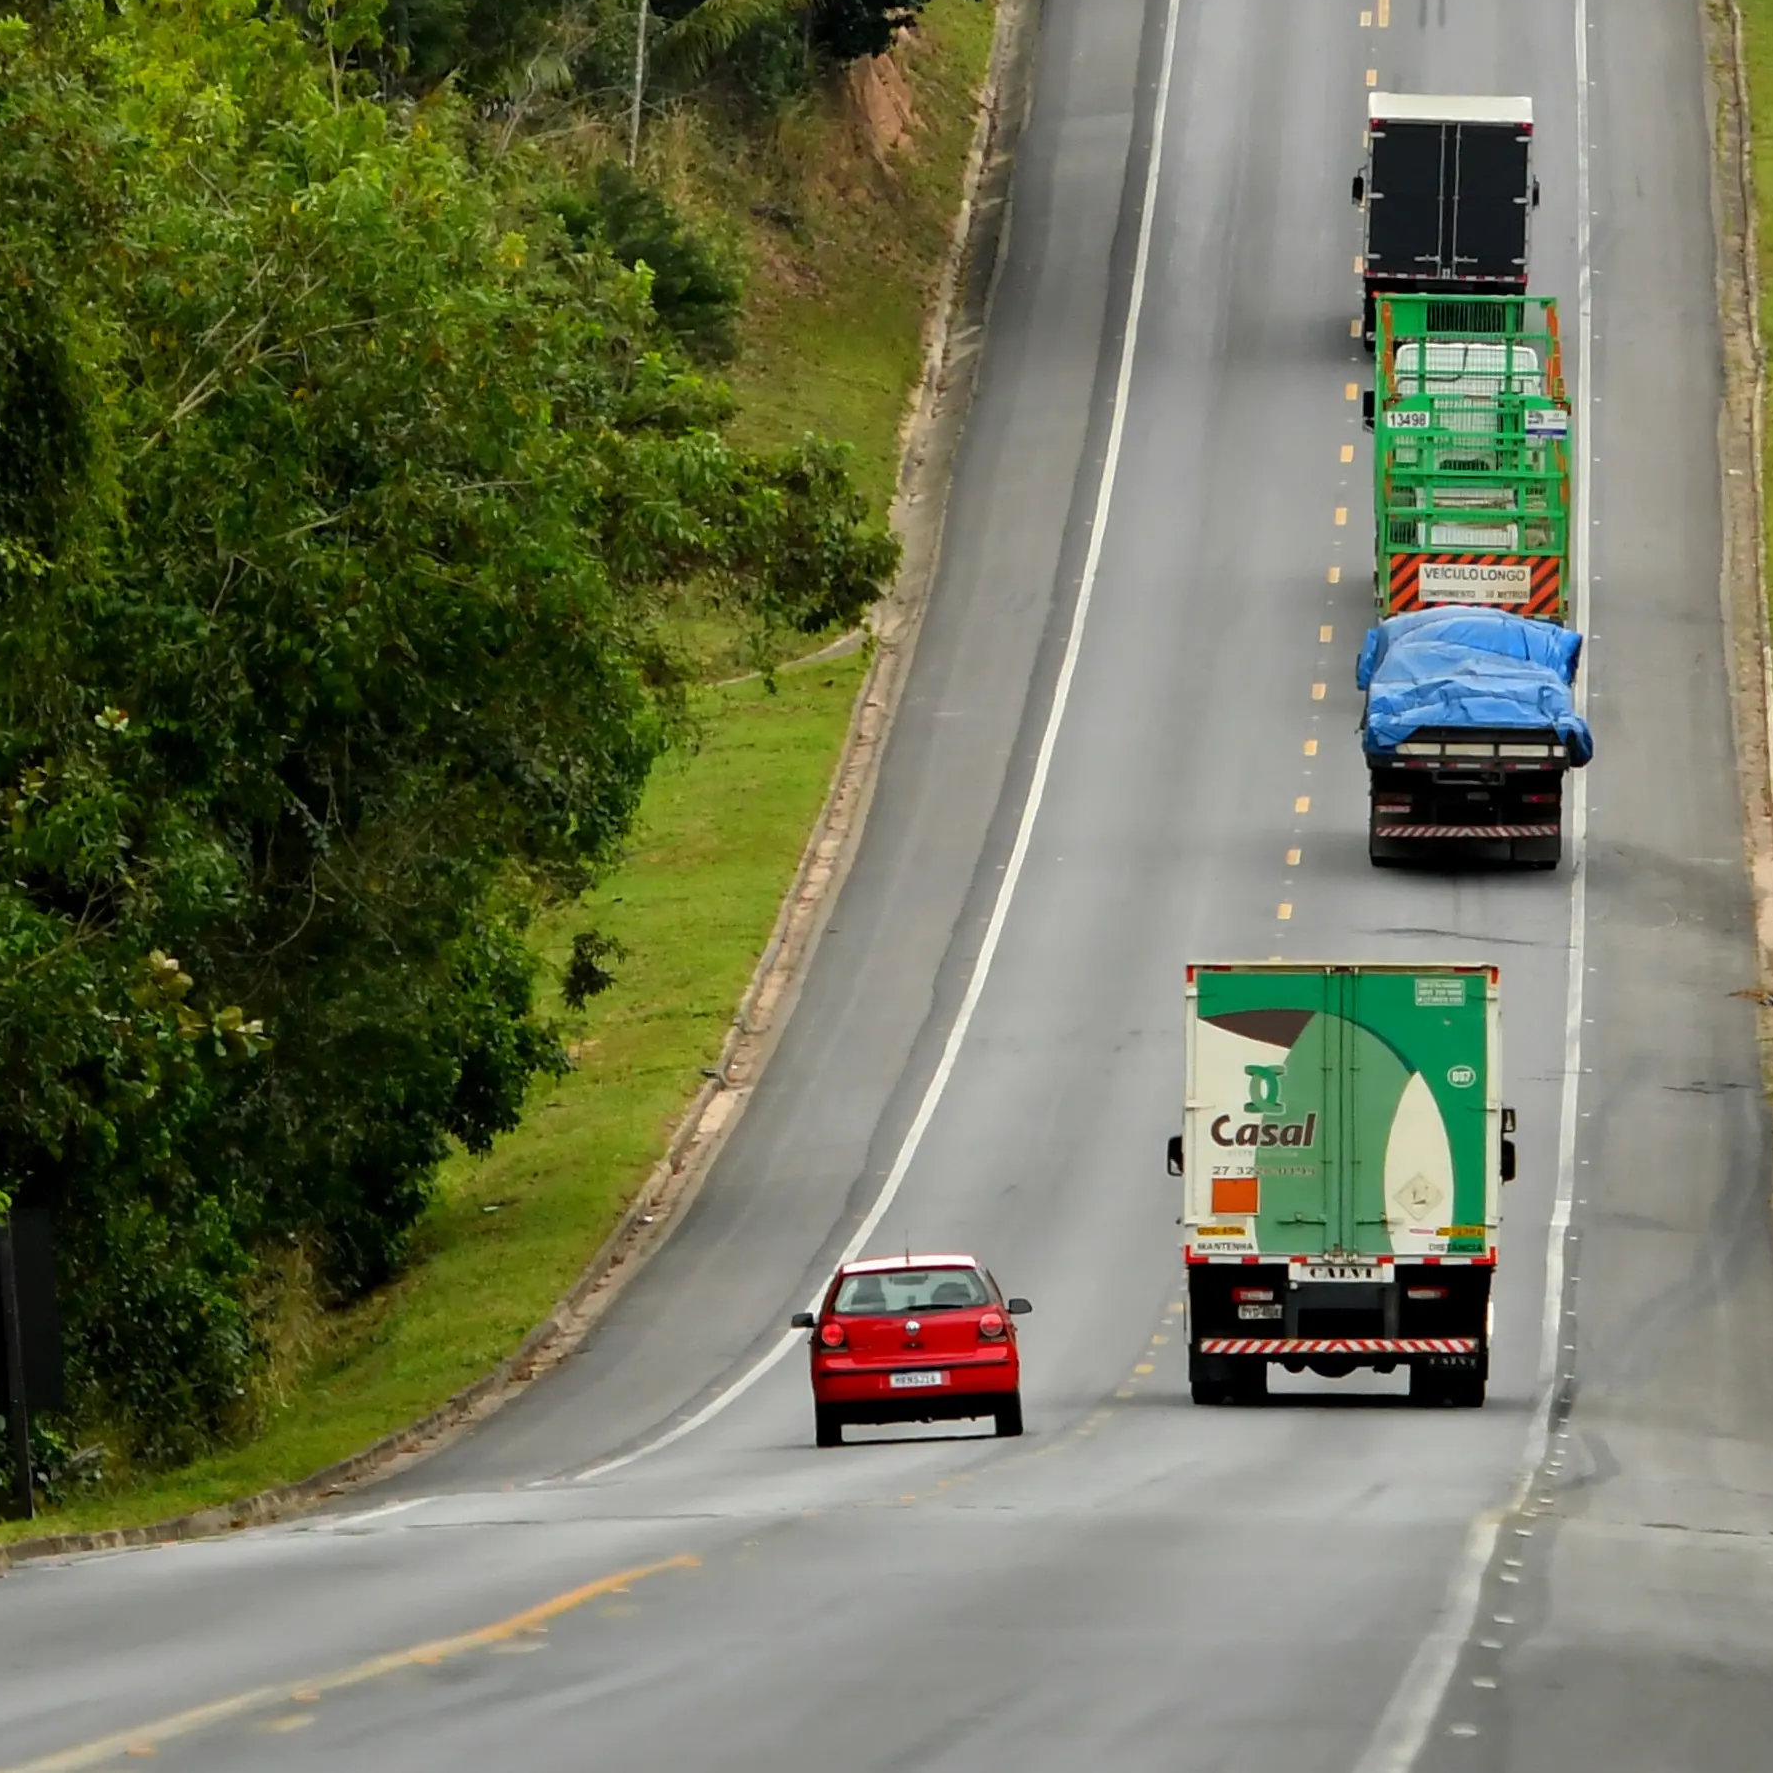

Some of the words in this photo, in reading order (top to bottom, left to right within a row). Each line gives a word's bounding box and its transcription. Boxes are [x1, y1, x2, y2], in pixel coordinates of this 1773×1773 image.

[1389, 412, 1427, 427] 13498
[1423, 566, 1479, 581] VEÍCULO
[1480, 569, 1526, 582] LONGO
[1210, 1112, 1317, 1147] Casal
[1212, 1166, 1230, 1176] 27
[1197, 1242, 1254, 1252] MANTENHA
